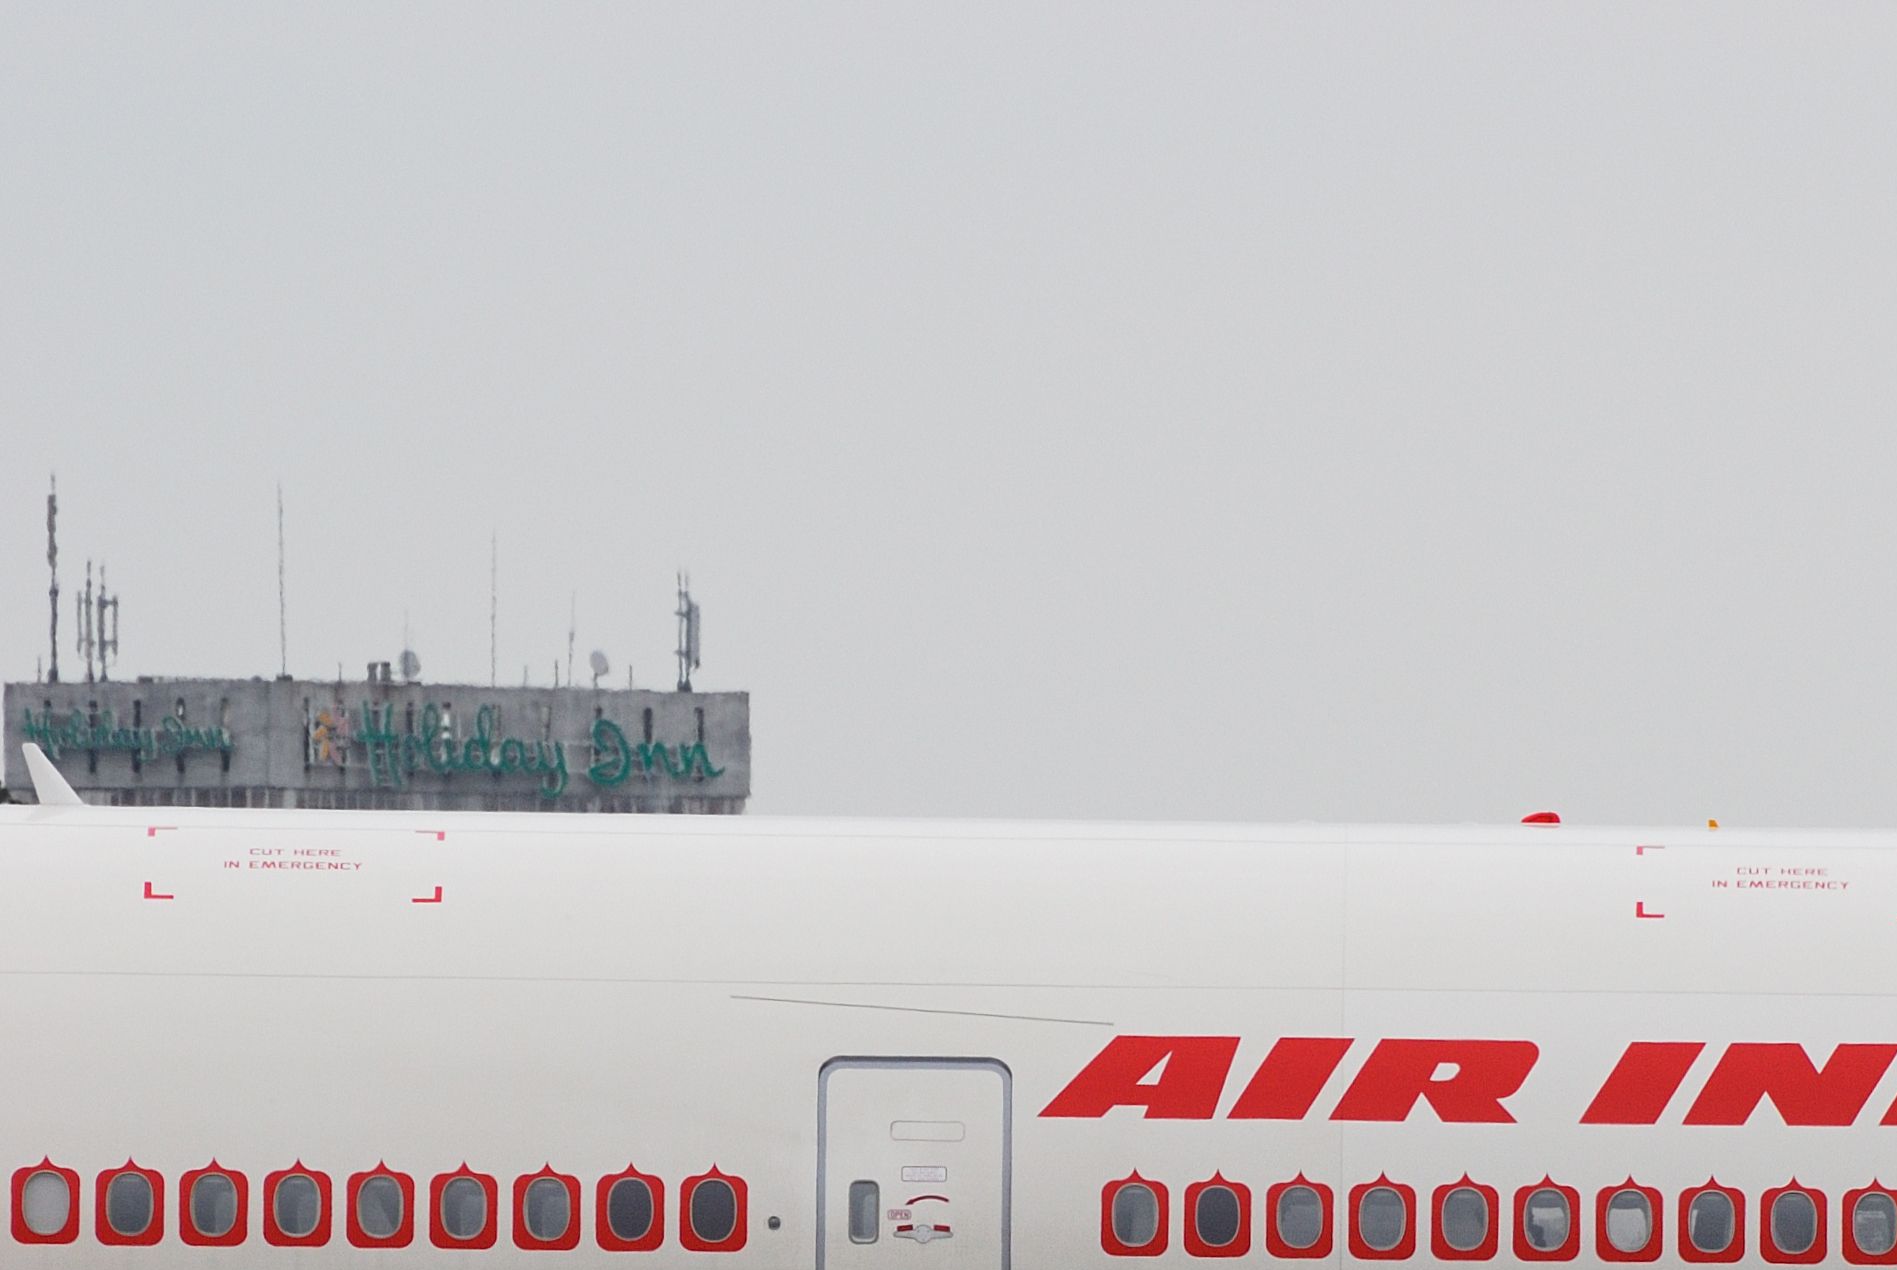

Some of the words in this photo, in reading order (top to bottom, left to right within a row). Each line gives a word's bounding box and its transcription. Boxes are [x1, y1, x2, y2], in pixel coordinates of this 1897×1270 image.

[22, 707, 157, 761] Holiday
[160, 715, 233, 754] Inn
[356, 700, 568, 799] Holiday
[587, 719, 726, 787] Inn
[249, 848, 285, 857] CUT
[294, 848, 342, 858] HERE
[223, 860, 240, 869] IN
[248, 860, 363, 871] EMERGENCY
[1736, 867, 1771, 876] CUT
[1780, 867, 1829, 877] HERE
[1711, 880, 1728, 888] IN
[1736, 880, 1850, 891] EMERGENCY
[1040, 1036, 1540, 1123] AIR
